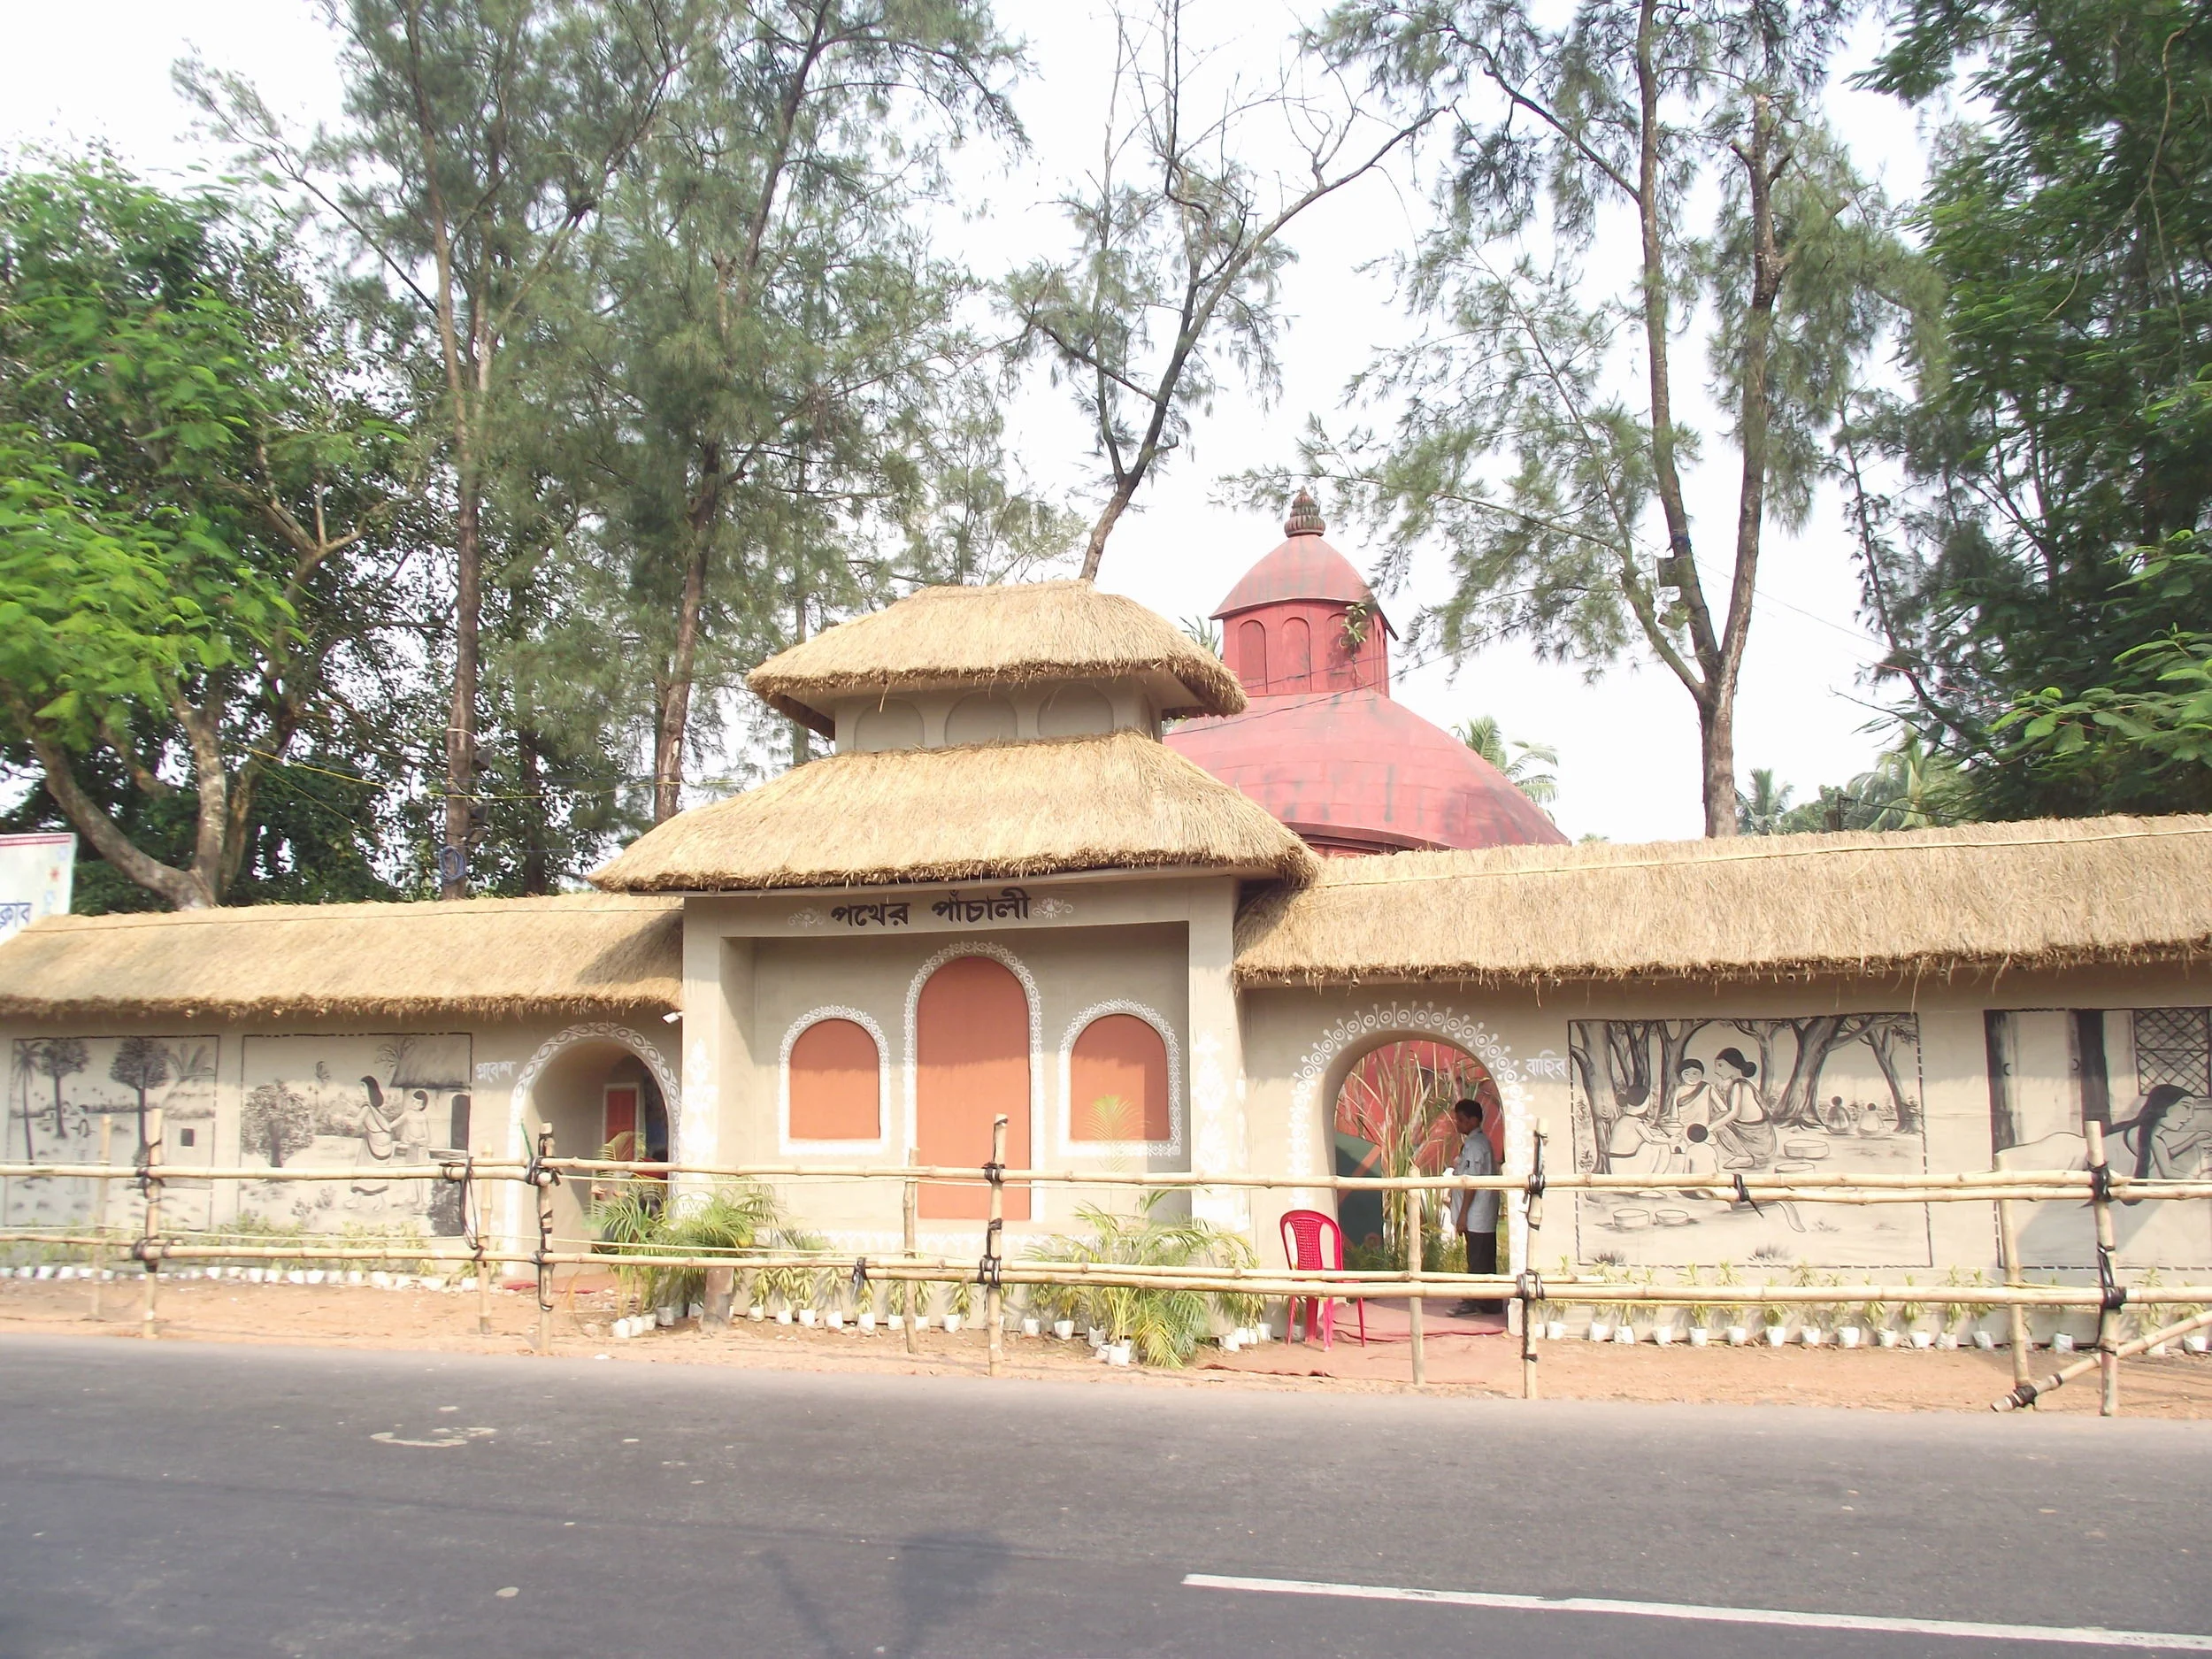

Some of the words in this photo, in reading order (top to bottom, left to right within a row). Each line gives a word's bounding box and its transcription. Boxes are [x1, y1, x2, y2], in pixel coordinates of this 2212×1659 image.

[830, 902, 910, 927] পথের
[932, 887, 1032, 923] পাঁচালী
[1525, 1049, 1567, 1079] বাহির
